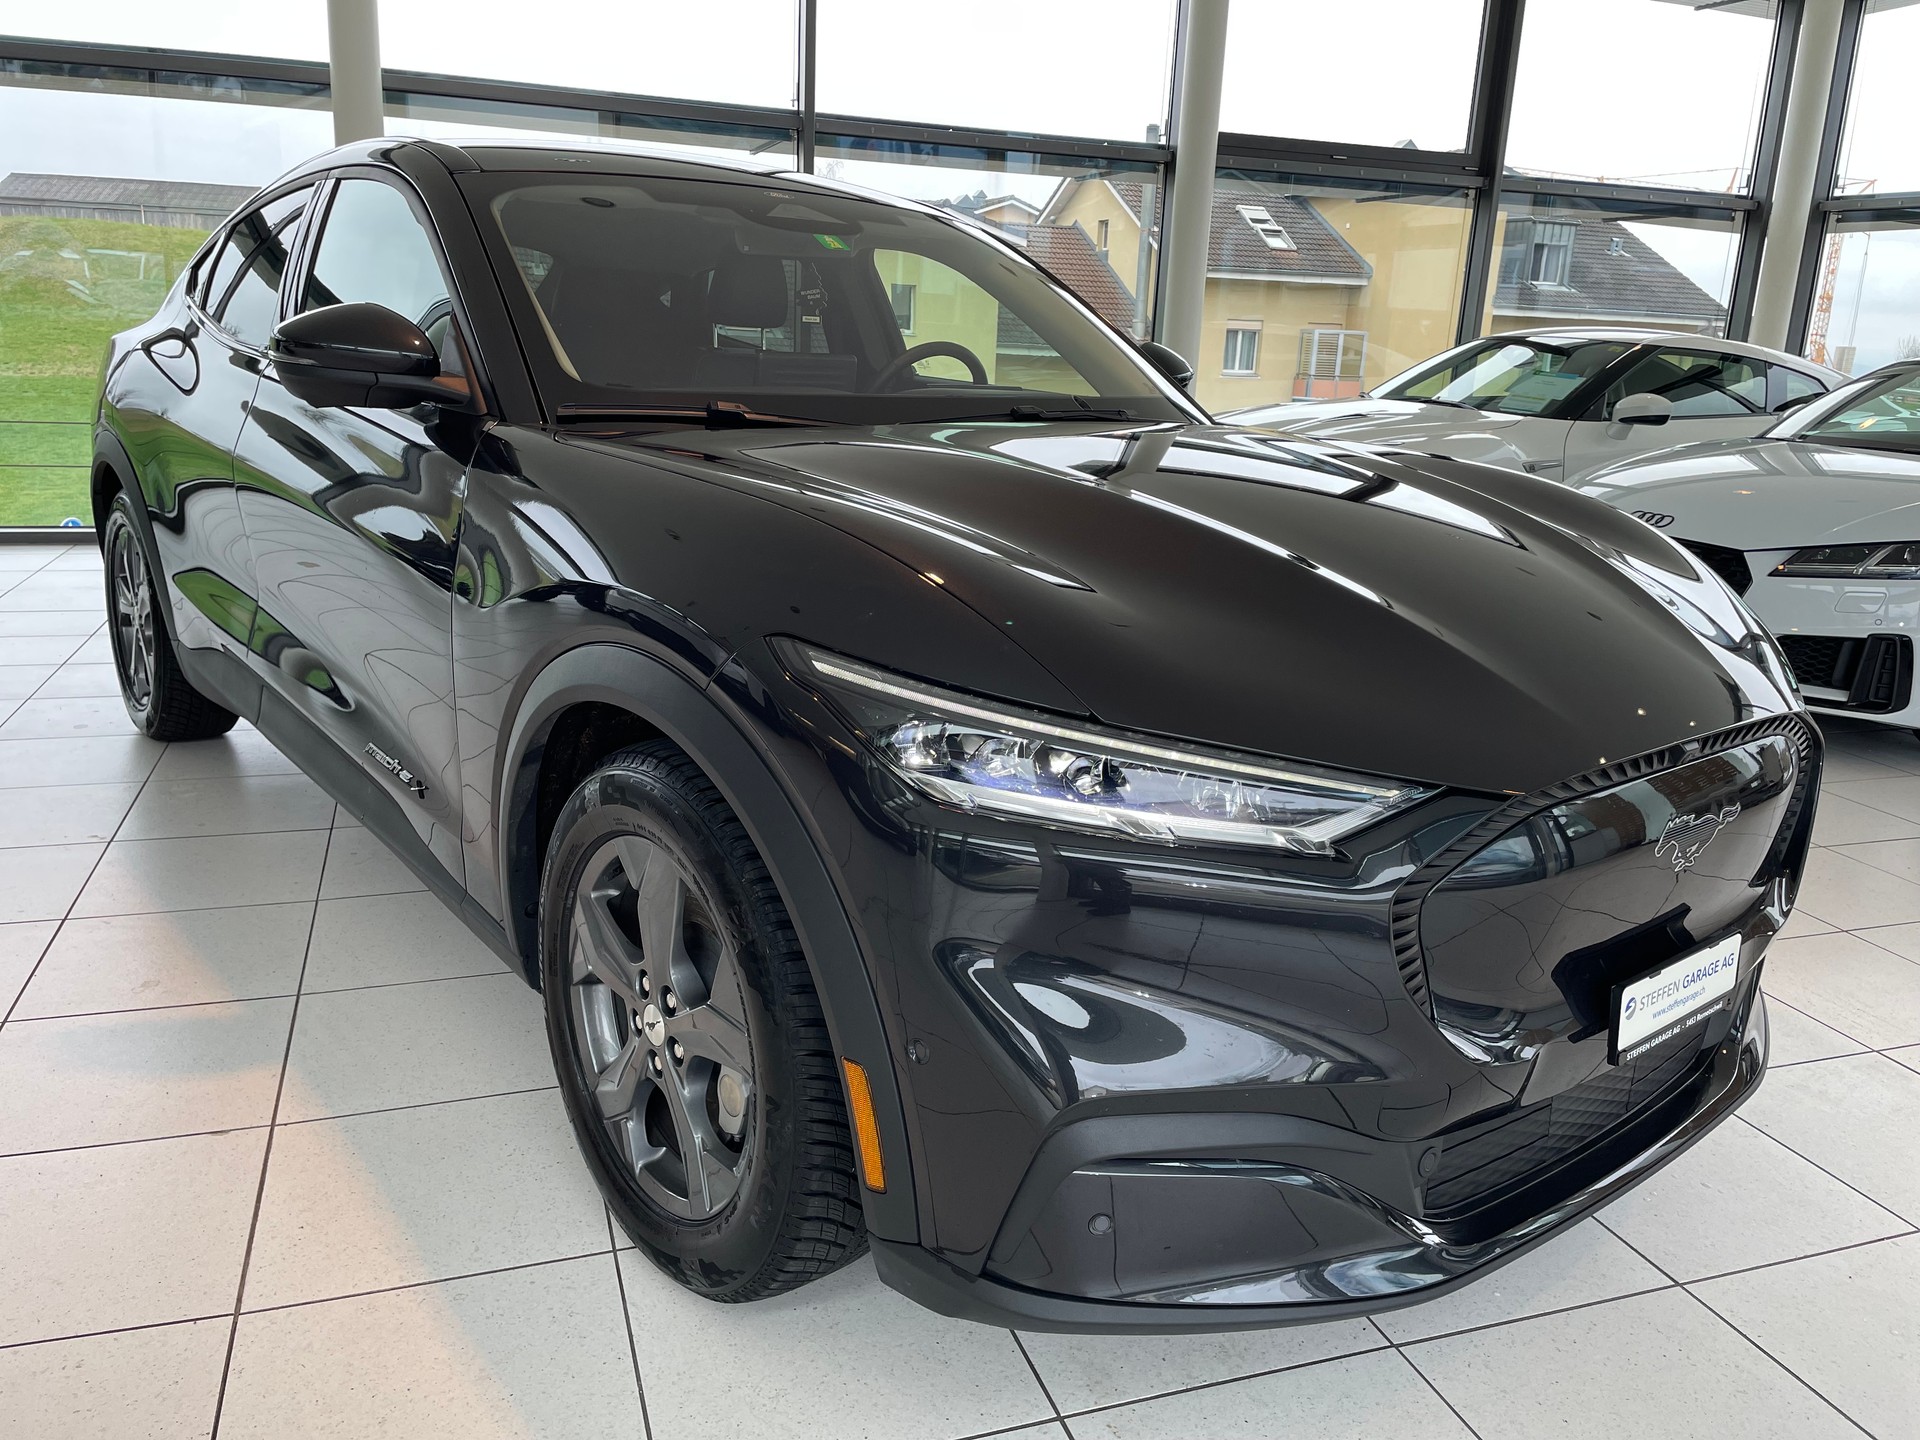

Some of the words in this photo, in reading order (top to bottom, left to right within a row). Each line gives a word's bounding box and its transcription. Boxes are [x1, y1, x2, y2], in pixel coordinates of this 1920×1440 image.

[1639, 978, 1681, 1011] STEFFEN
[1682, 959, 1720, 989] GARAGE
[1720, 952, 1735, 971] AG
[1651, 985, 1706, 1020] www.steffengarage.ch
[1626, 1041, 1650, 1061] STEFFEN
[1650, 1029, 1673, 1050] GARAGE
[1672, 1024, 1681, 1036] AG
